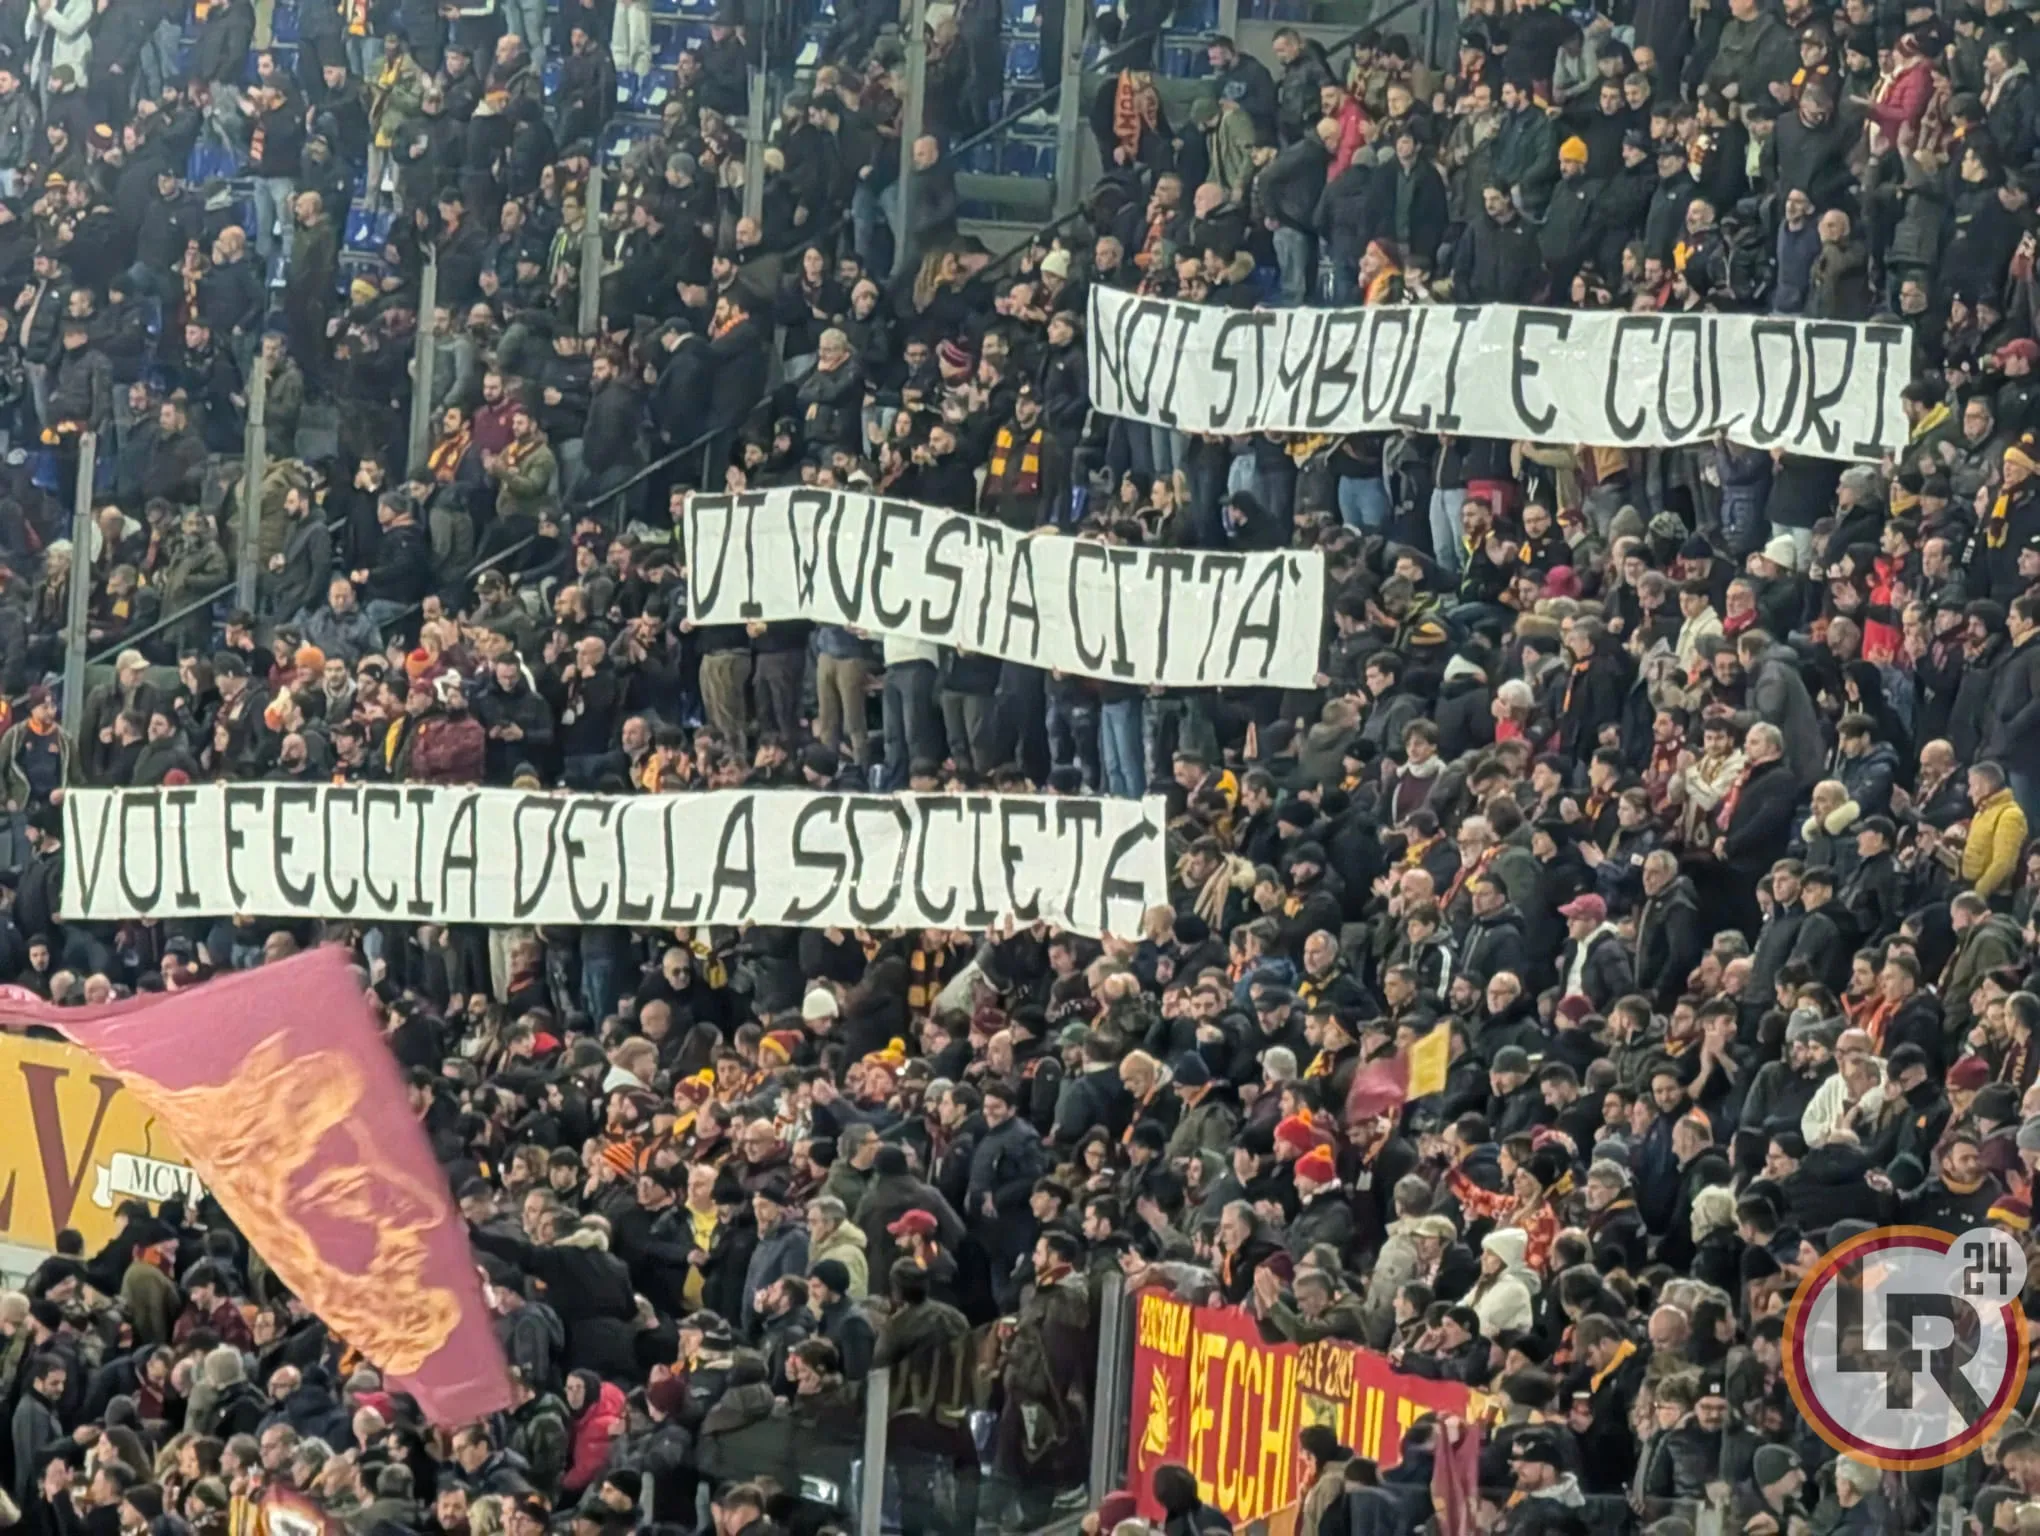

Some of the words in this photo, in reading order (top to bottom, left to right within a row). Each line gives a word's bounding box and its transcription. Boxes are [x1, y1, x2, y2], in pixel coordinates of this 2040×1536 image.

[1093, 292, 1198, 424] NOI
[1209, 306, 1481, 431] SIMBOLI
[1511, 309, 1572, 434] E
[1604, 315, 1904, 457] COLORI
[690, 494, 766, 619] DI
[788, 488, 1042, 658] QUESTA
[69, 790, 201, 917] VOI
[224, 786, 481, 919] FECCIA
[513, 795, 757, 922] DELLA
